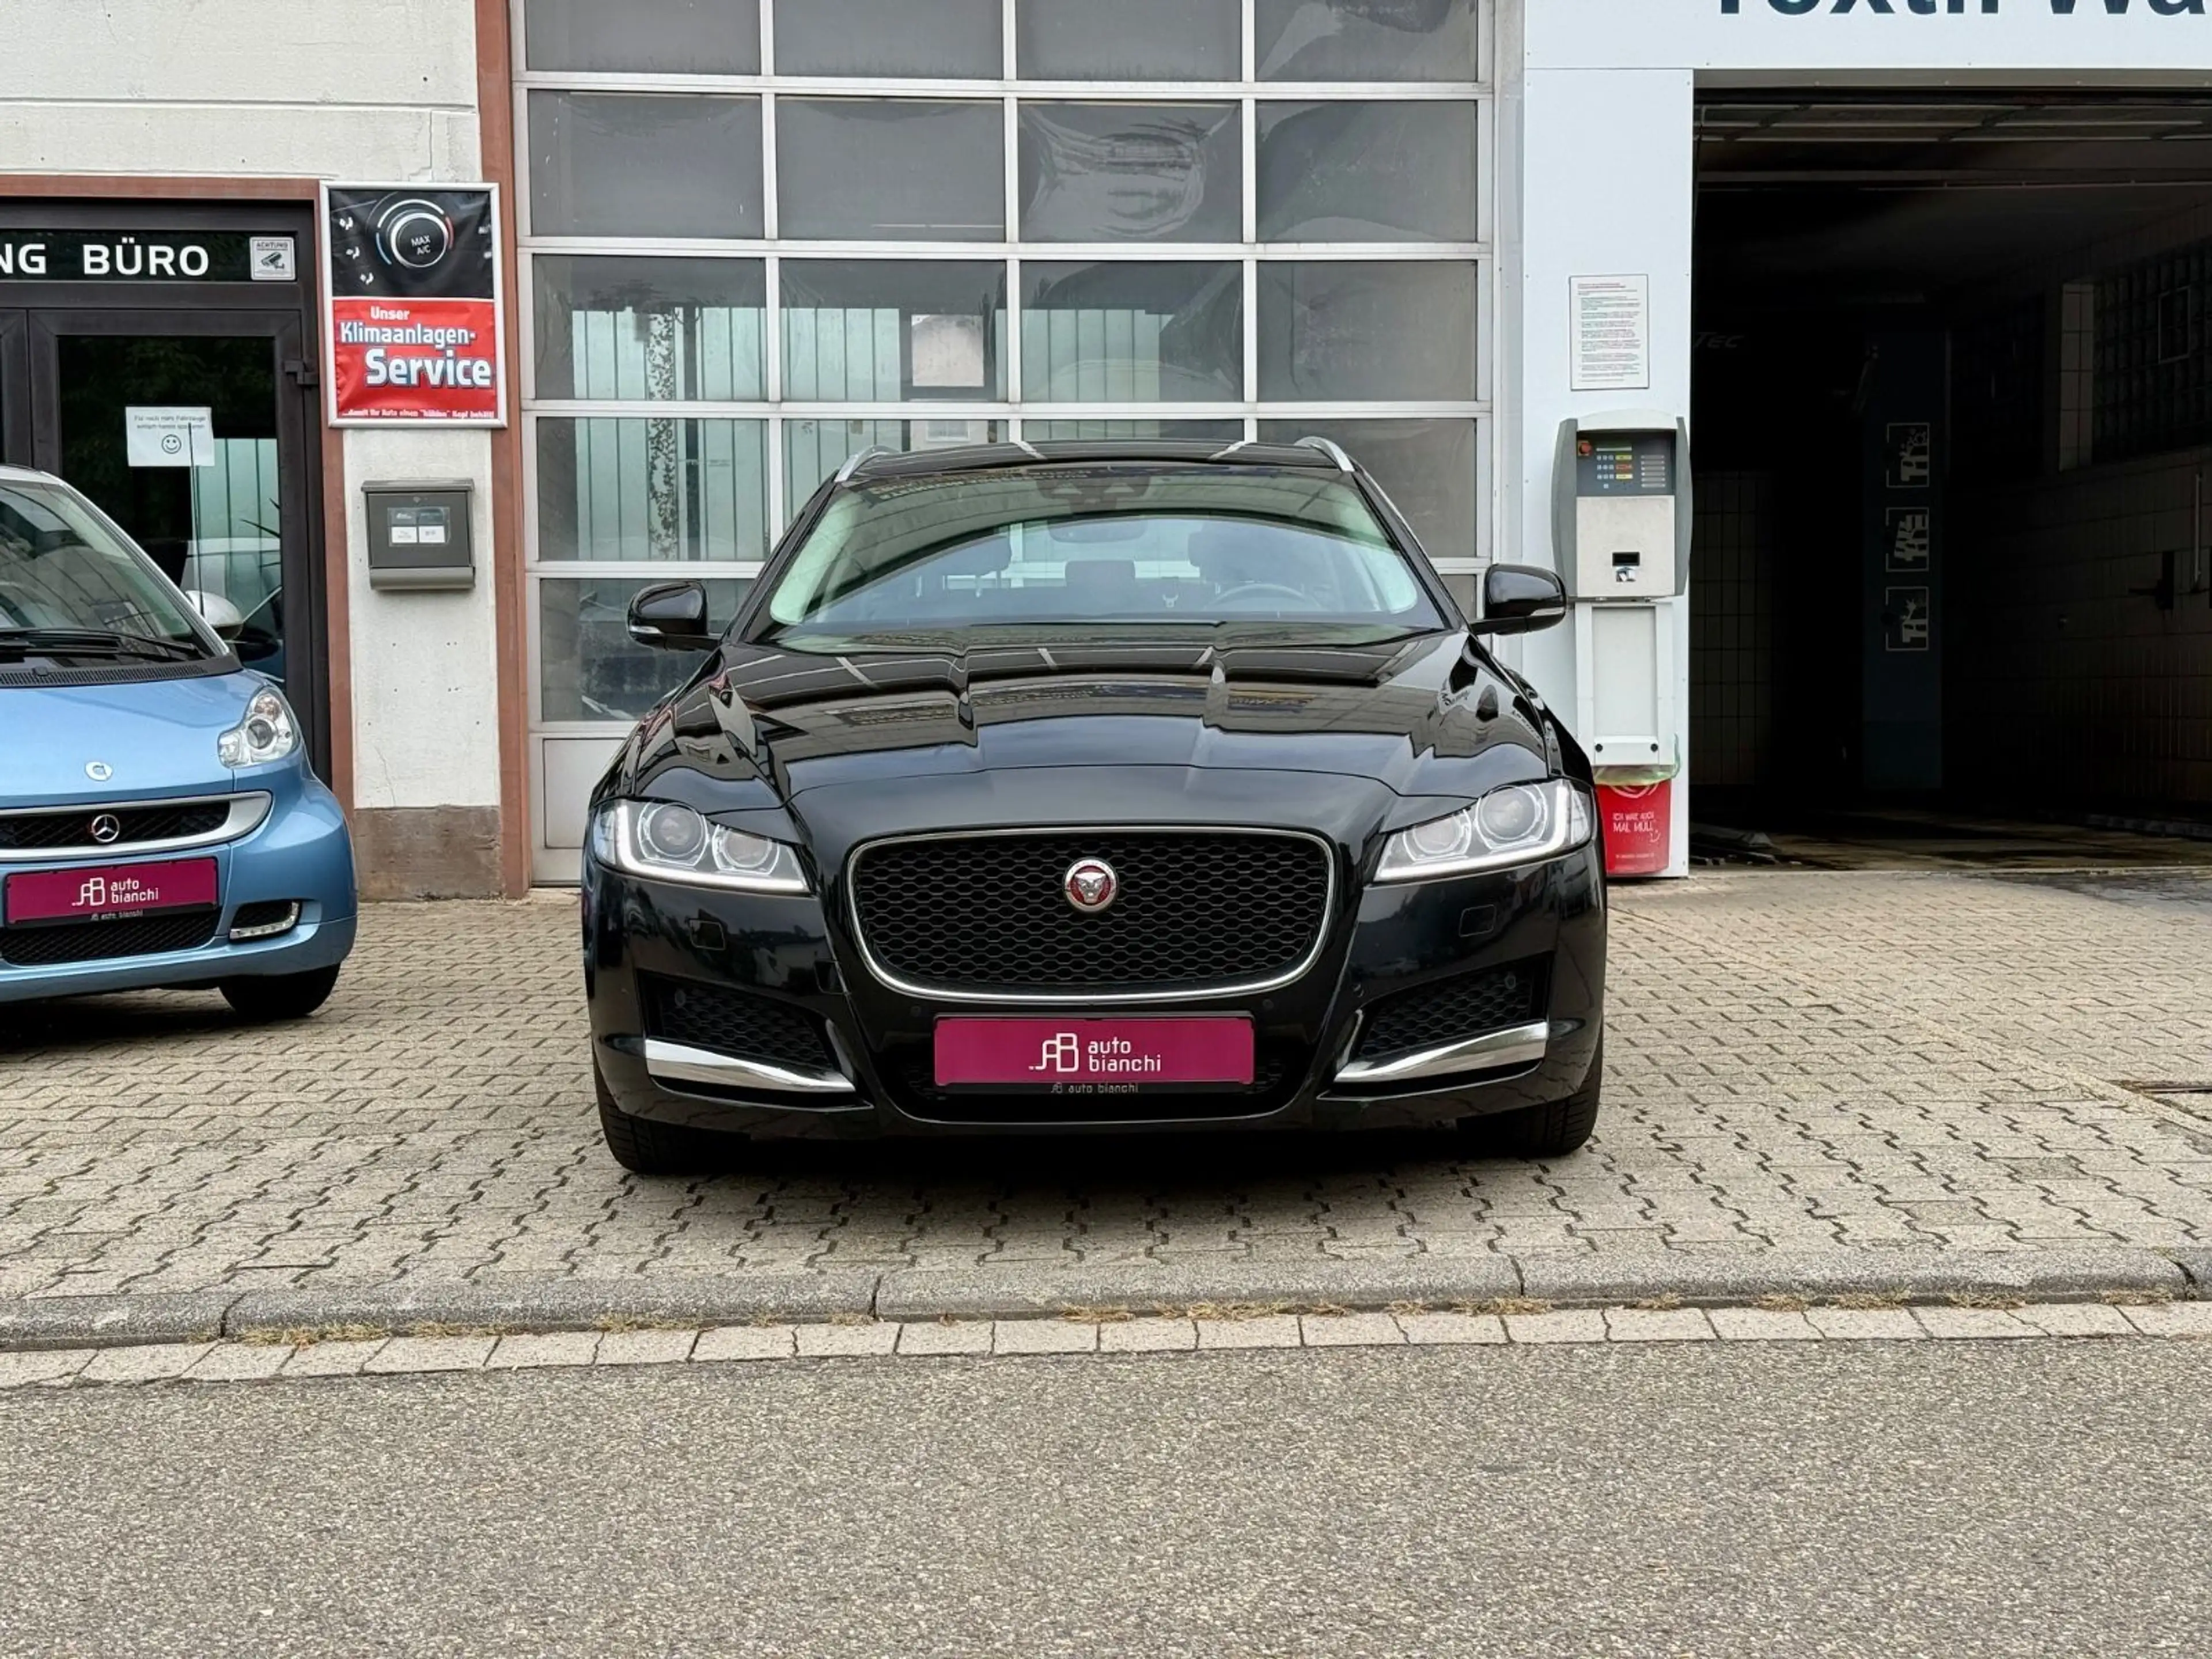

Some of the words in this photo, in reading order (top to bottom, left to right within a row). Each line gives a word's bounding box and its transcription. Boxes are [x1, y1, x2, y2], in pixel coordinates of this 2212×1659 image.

[411, 236, 431, 247] MAX
[83, 237, 209, 276] BÜRO
[416, 246, 432, 256] A/C
[370, 306, 410, 320] Unser
[340, 321, 476, 349] Klimaanlagen-
[365, 348, 491, 387] Service
[111, 878, 139, 891] auto
[111, 888, 159, 904] bianchi
[1088, 1037, 1131, 1054] auto
[1089, 1054, 1161, 1072] bianchi
[1069, 1084, 1093, 1093] auto
[1098, 1081, 1139, 1093] bianchi
